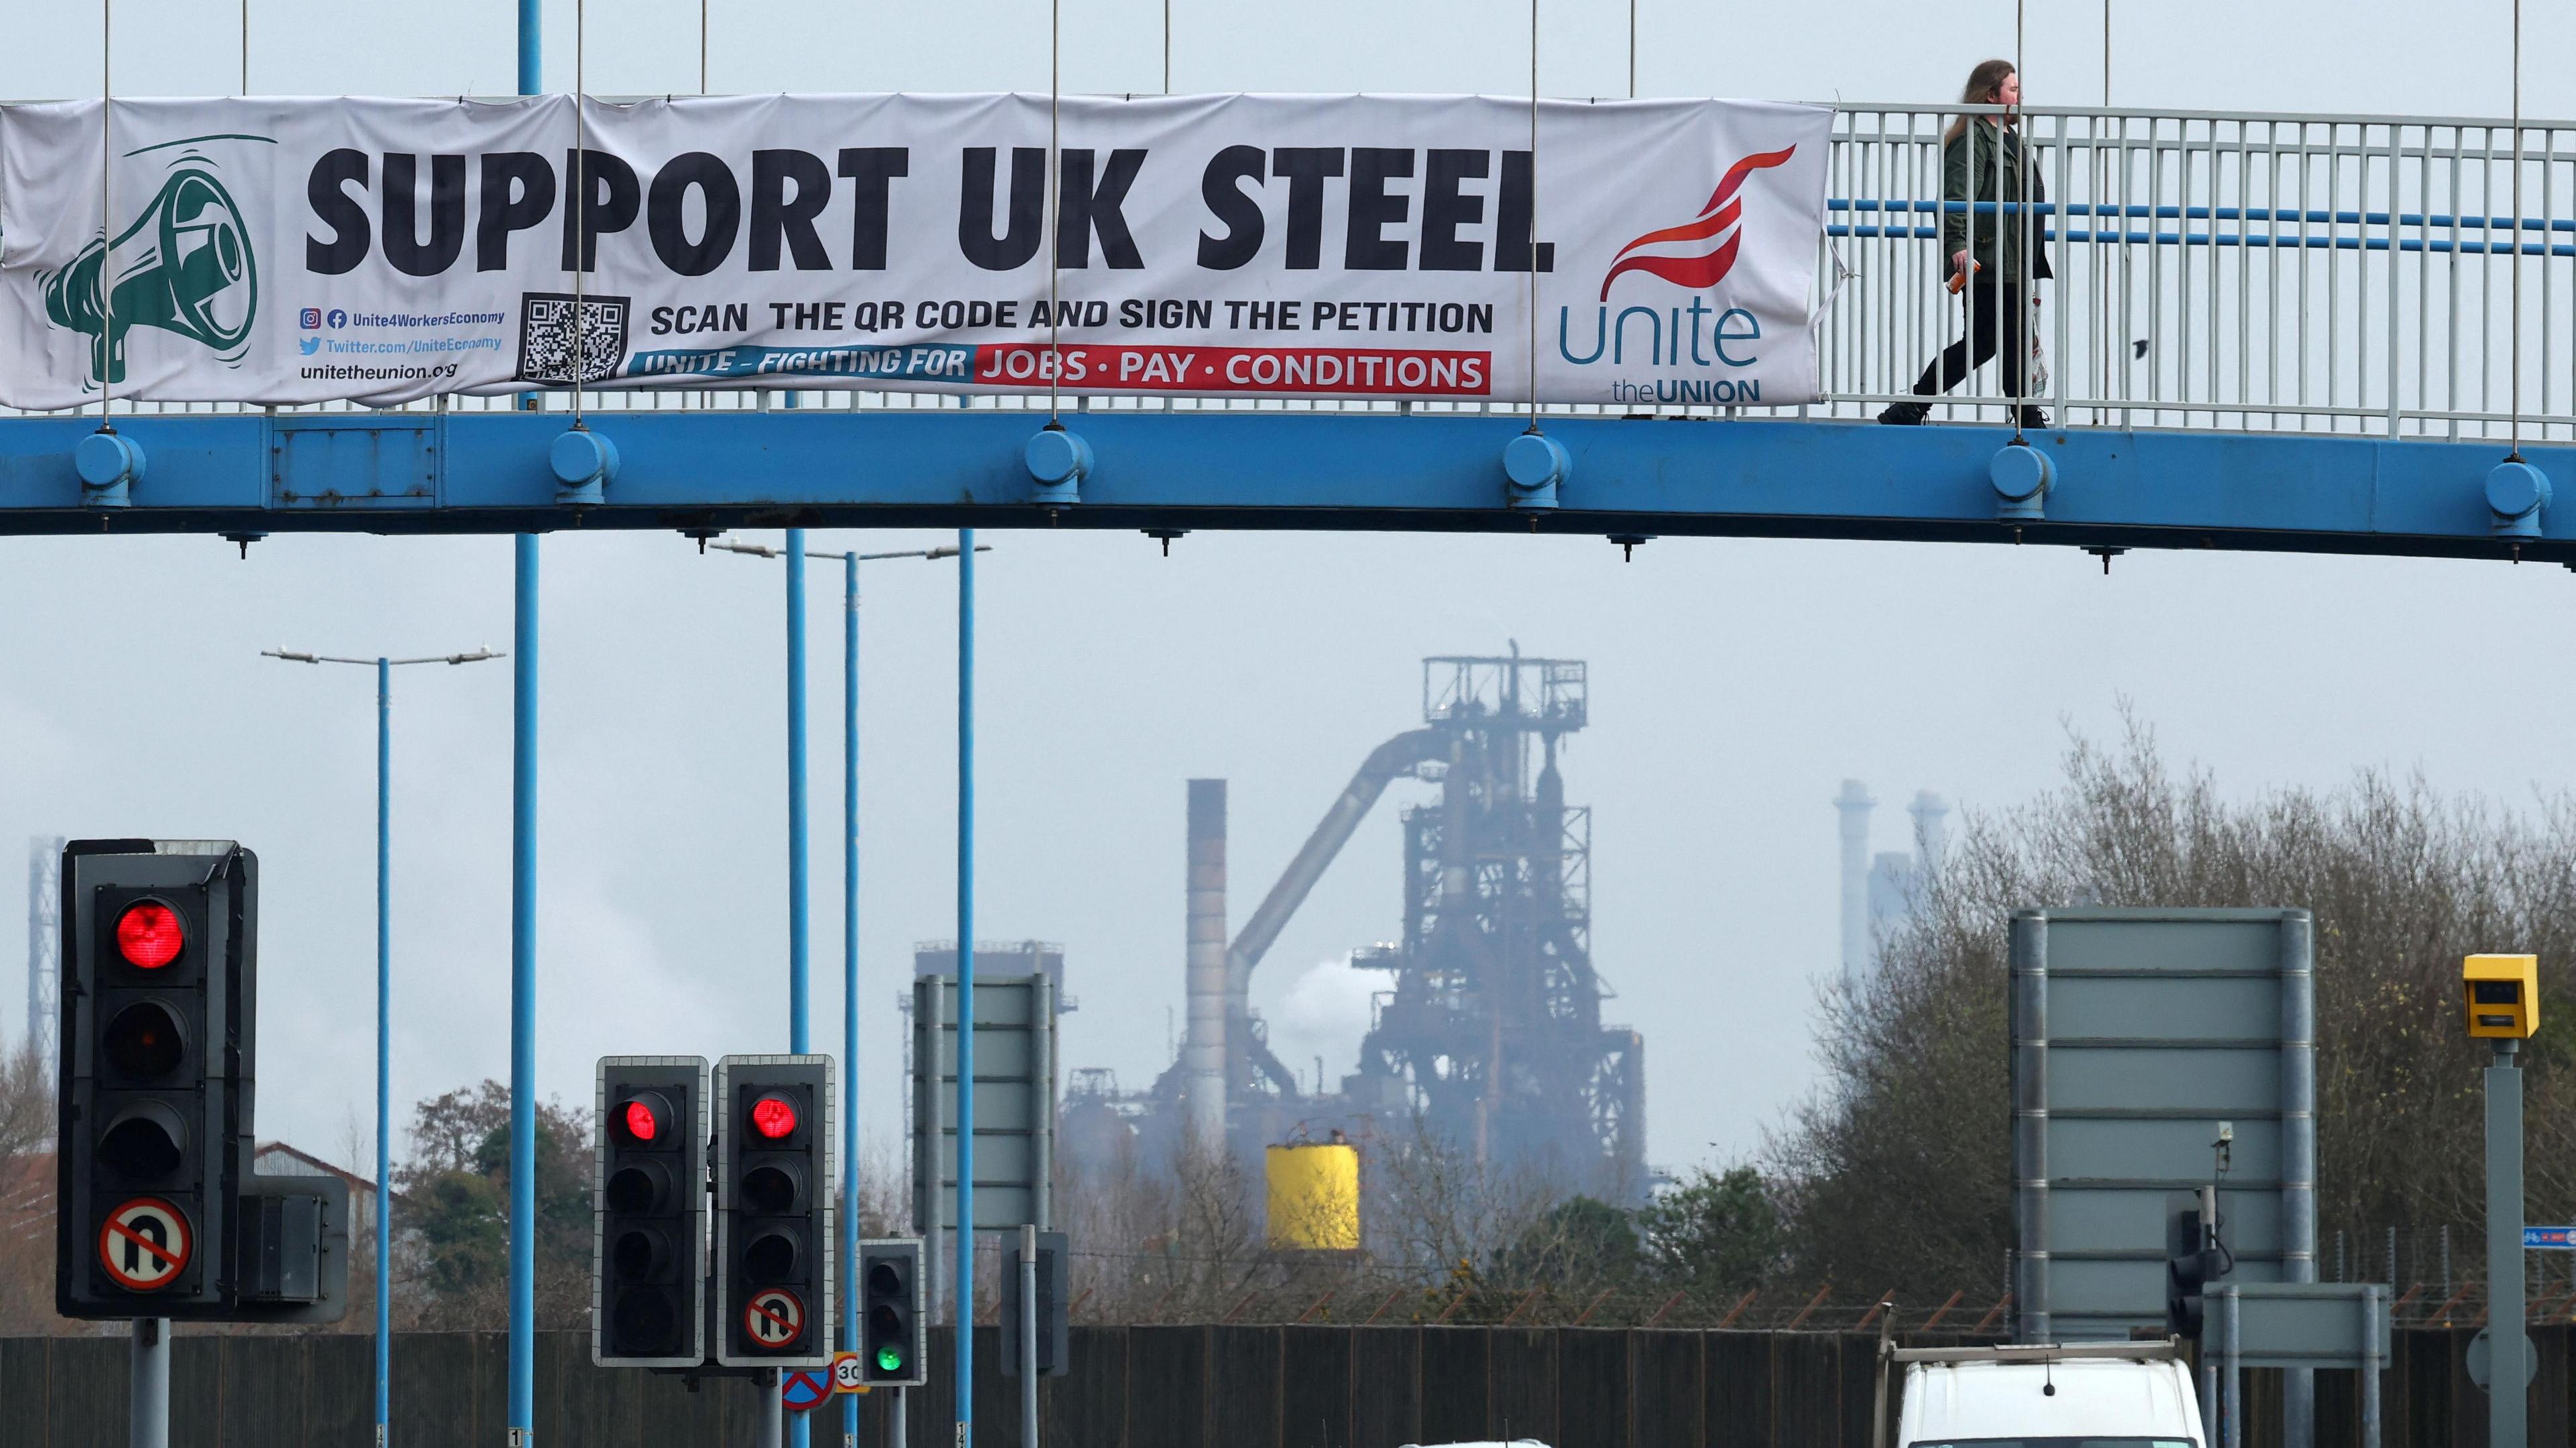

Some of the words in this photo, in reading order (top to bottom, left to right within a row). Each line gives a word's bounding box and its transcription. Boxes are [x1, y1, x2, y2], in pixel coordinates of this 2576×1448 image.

[307, 147, 909, 276] SUPPORT
[959, 147, 1149, 271] UK
[1197, 145, 1555, 272] STEEL
[354, 311, 505, 327] Unite4WorkersEconomy
[651, 302, 748, 335] SCAN
[769, 302, 847, 331] THE
[854, 300, 906, 334] QR
[915, 300, 1018, 329] CODE
[1027, 300, 1108, 329] AND
[1120, 299, 1213, 329] SIGN
[1224, 300, 1301, 331] THE
[1312, 301, 1493, 334] PETITION
[327, 337, 502, 354] Twitter.com/UniteEconomy
[1559, 295, 1761, 368] unite
[644, 350, 737, 374] UNITE
[757, 349, 902, 374] FIGHTING
[906, 348, 967, 376] FOR
[981, 349, 1087, 382] JOBS
[1120, 351, 1195, 383] PAY
[1225, 353, 1483, 389] CONDITIONS
[1612, 379, 1761, 403] theUNION
[839, 1366, 858, 1380] 30
